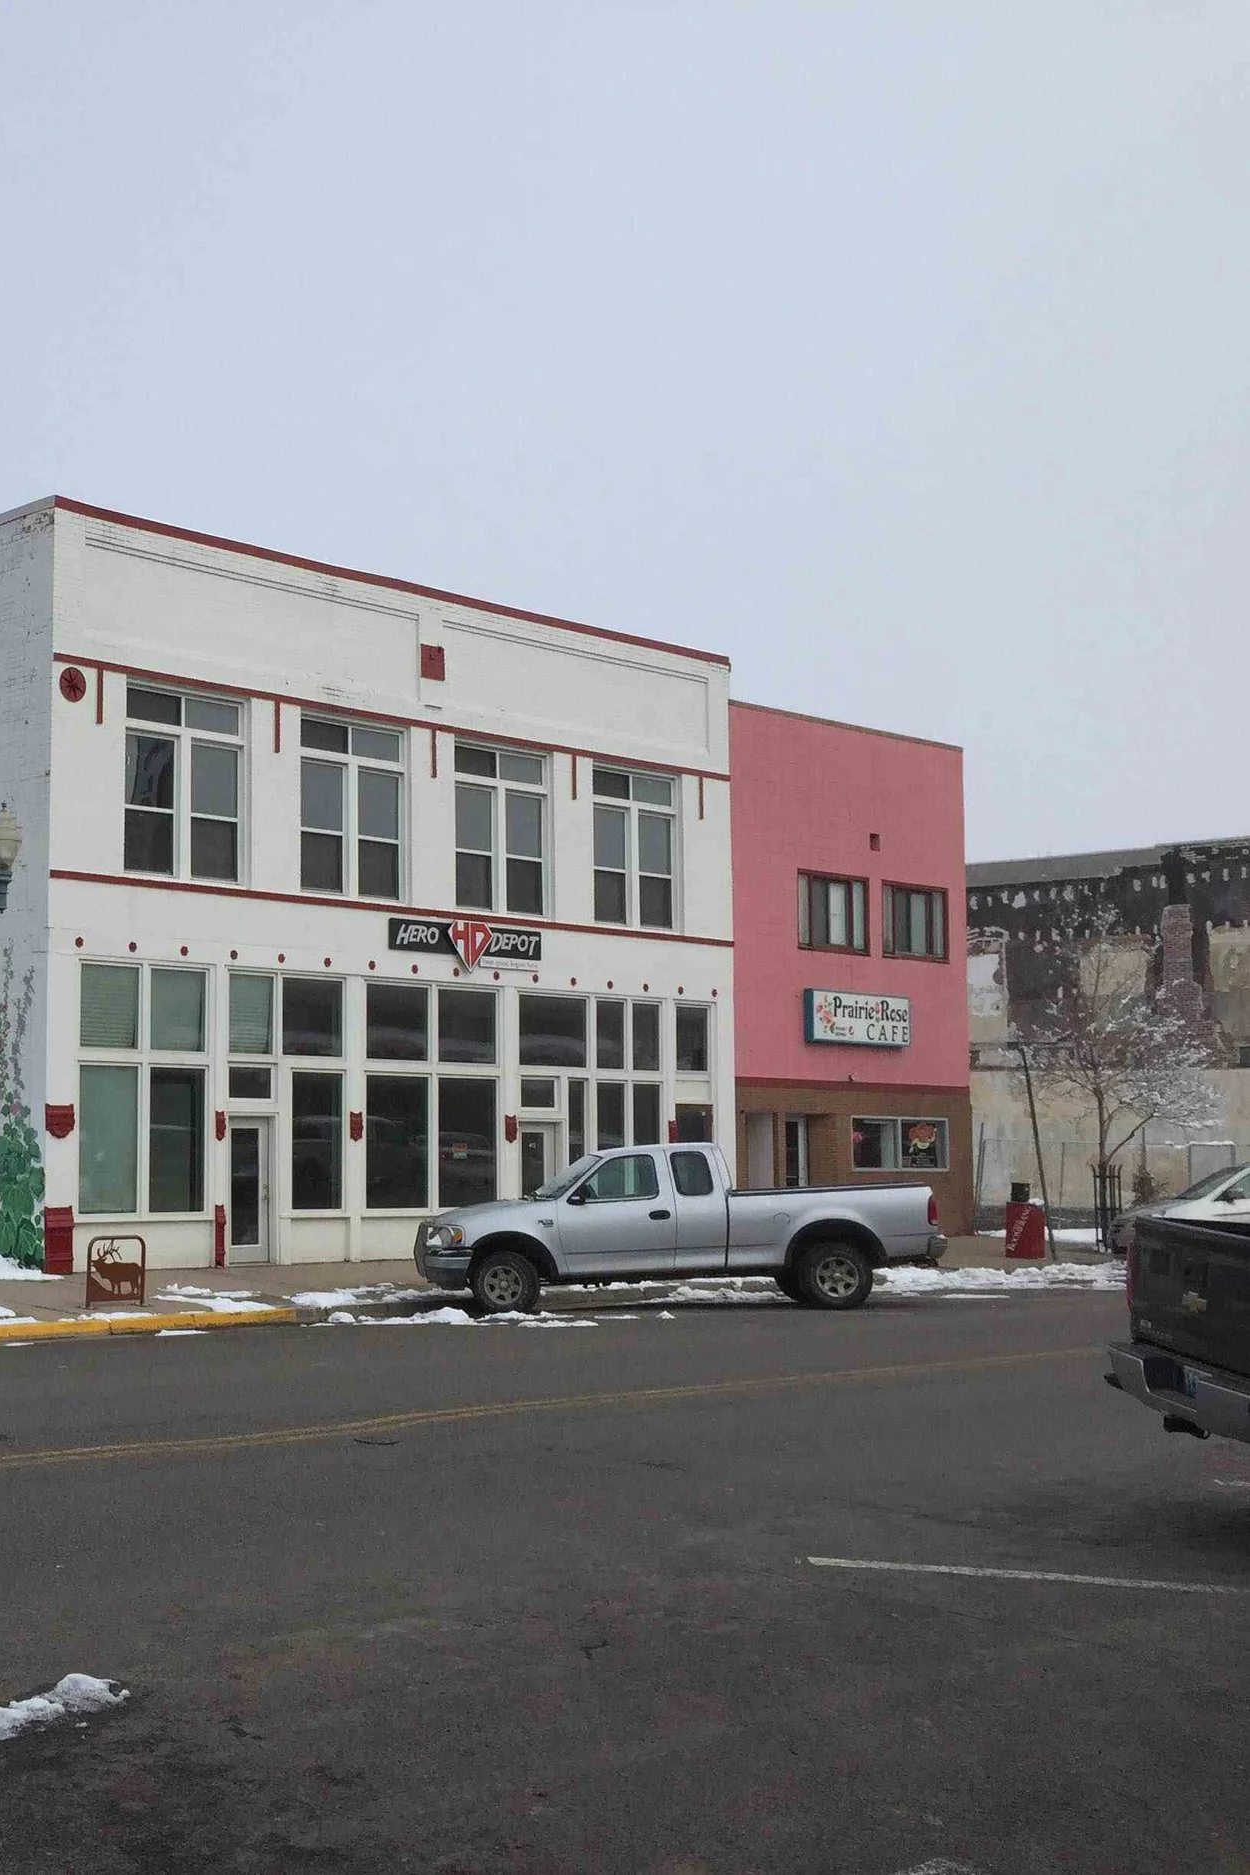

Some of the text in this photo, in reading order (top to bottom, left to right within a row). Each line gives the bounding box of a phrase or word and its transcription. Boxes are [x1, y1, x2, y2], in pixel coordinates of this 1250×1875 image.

[396, 923, 440, 945] HERO
[490, 931, 540, 957] DEPOT
[832, 996, 908, 1022] Prairie Rose
[866, 1023, 909, 1043] CAFE
